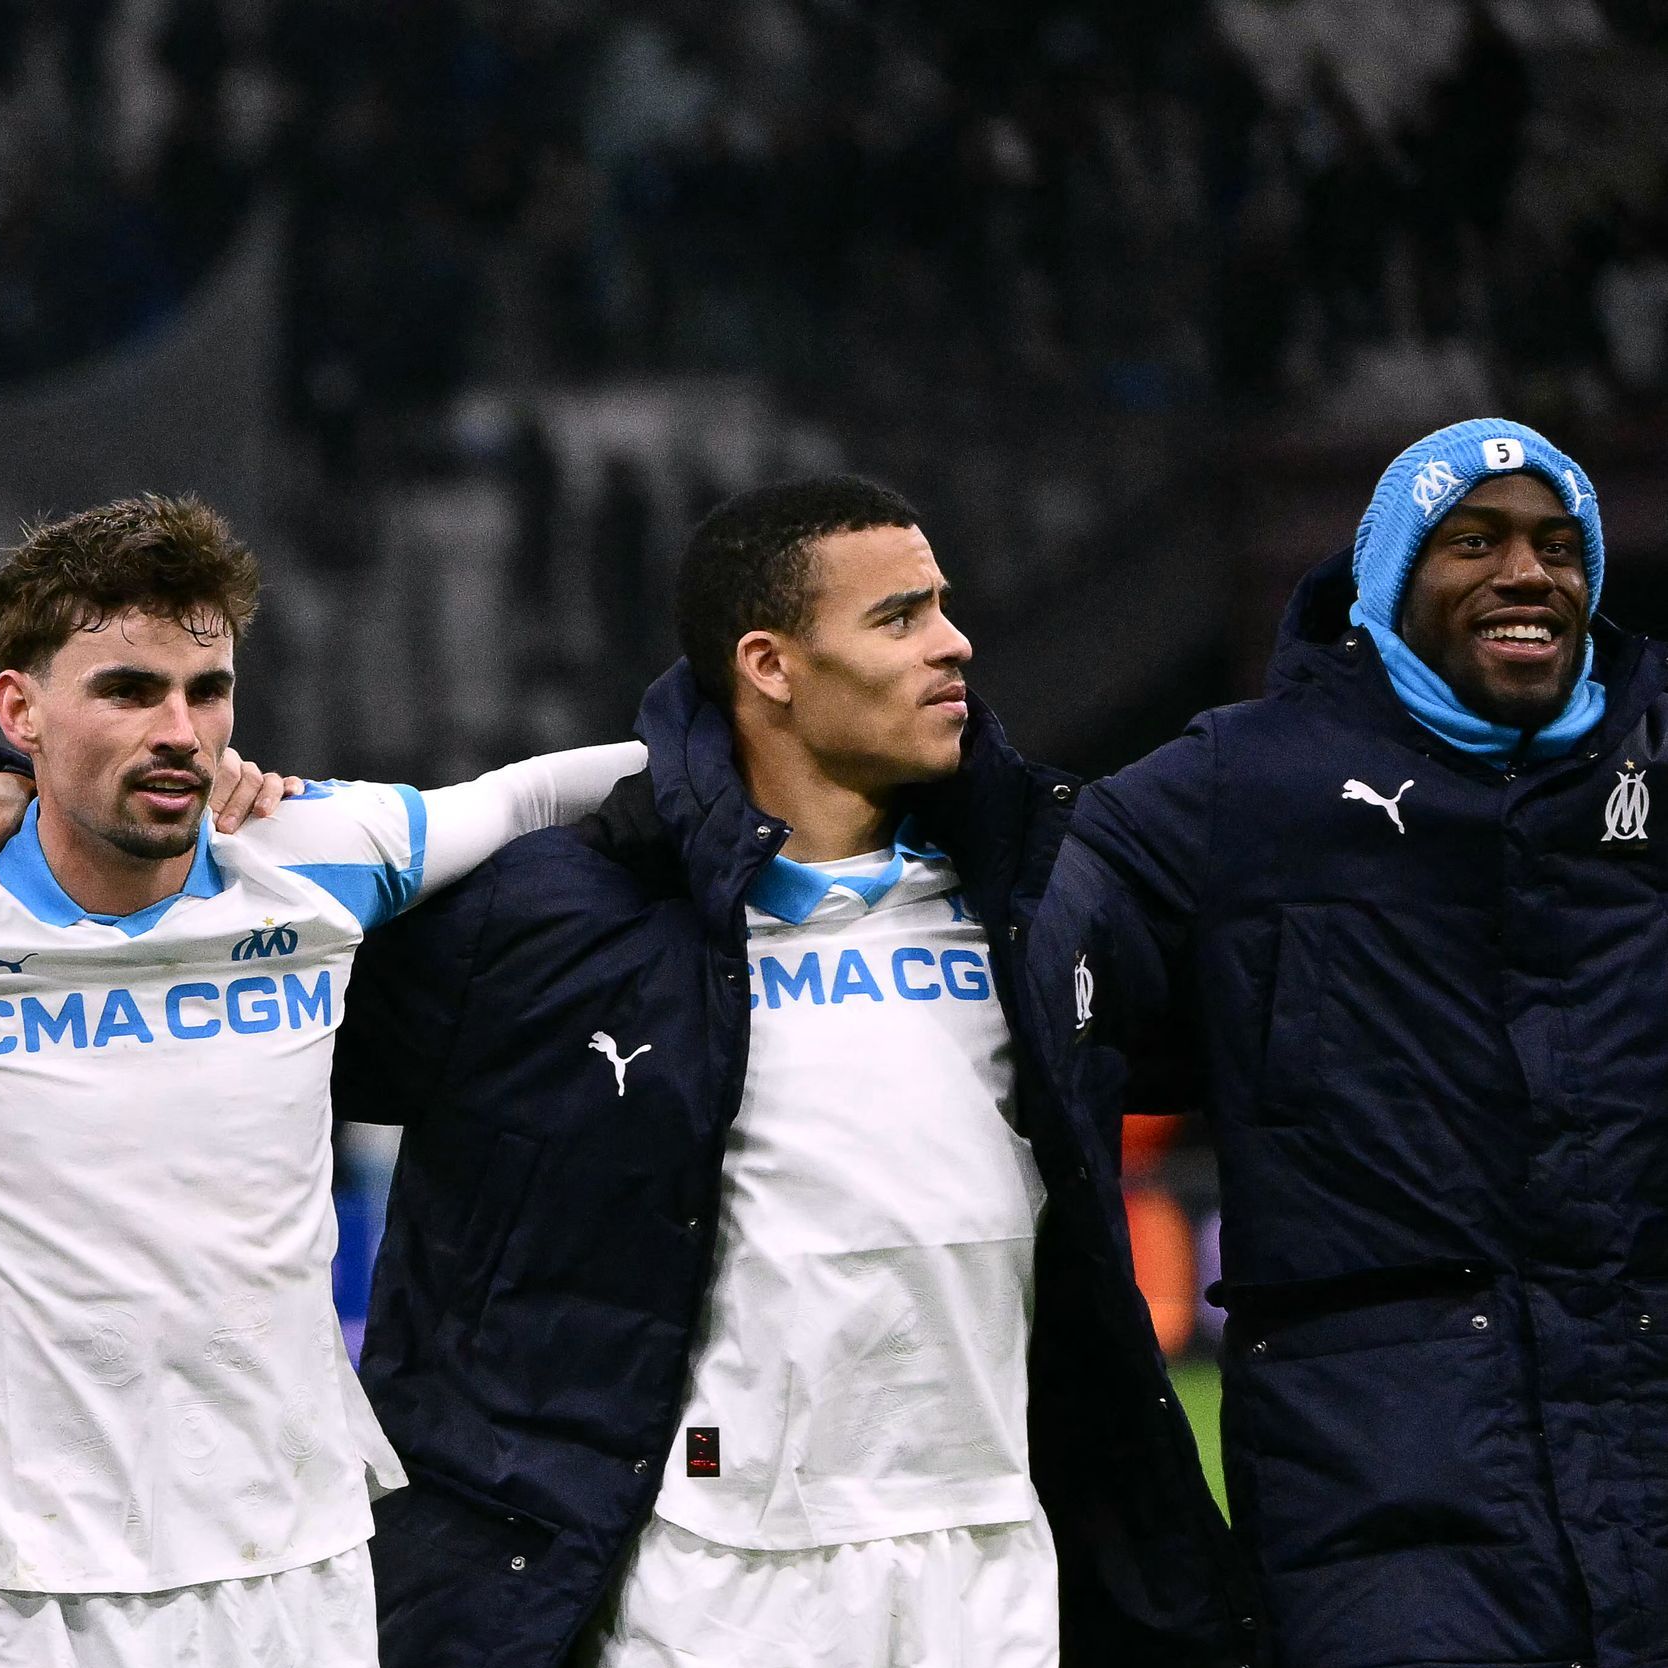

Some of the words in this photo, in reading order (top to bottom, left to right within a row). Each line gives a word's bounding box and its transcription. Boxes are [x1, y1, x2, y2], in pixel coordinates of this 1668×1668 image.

[1496, 443, 1510, 463] 5
[165, 970, 333, 1040] CGM
[748, 949, 884, 1010] MA
[891, 947, 996, 1002] CG
